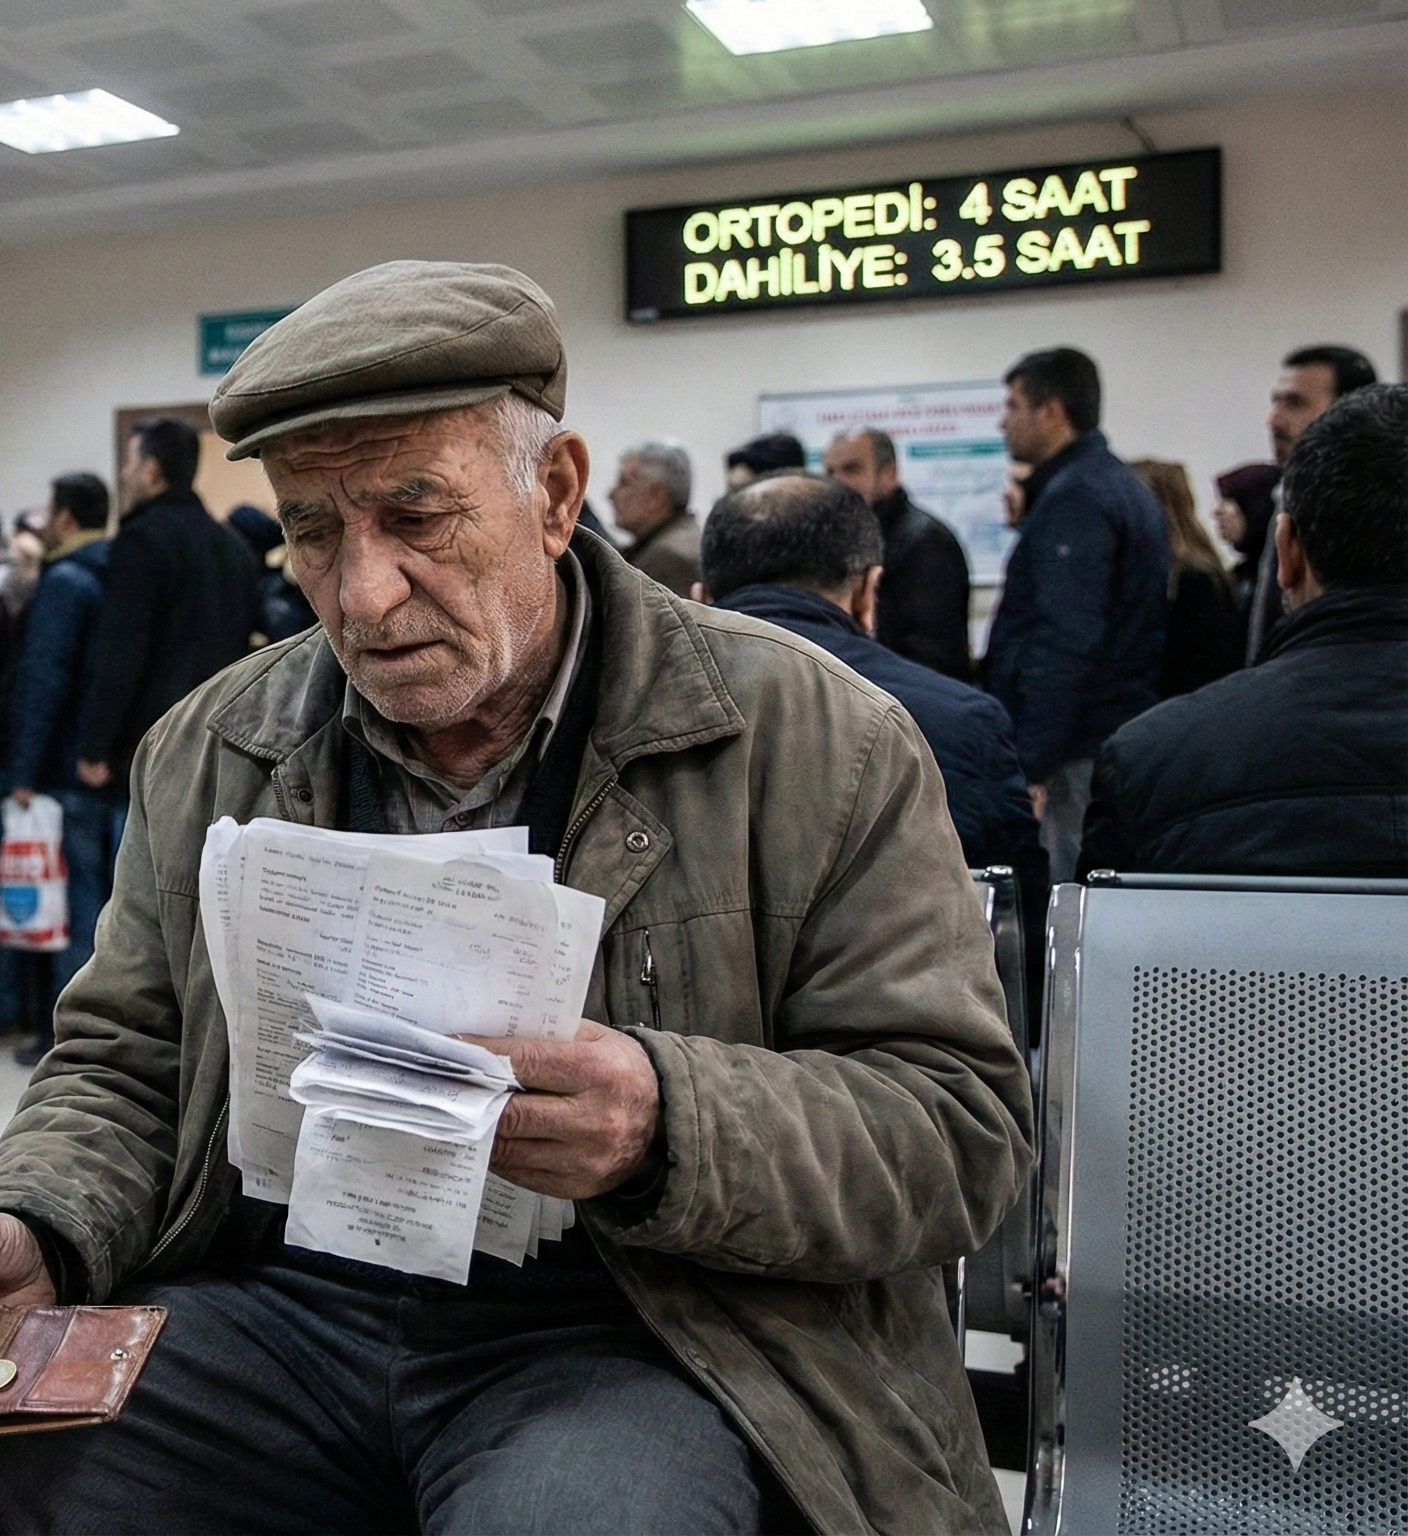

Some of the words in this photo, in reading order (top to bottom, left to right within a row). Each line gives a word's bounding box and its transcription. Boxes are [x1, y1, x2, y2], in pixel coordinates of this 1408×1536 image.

[683, 181, 937, 254] ORTOPEDİ:
[959, 181, 992, 226] 4
[1001, 166, 1138, 222] SAAT
[684, 243, 908, 304] DAHİLİYE:
[931, 233, 1006, 282] 3.5
[1015, 219, 1151, 274] SAAT
